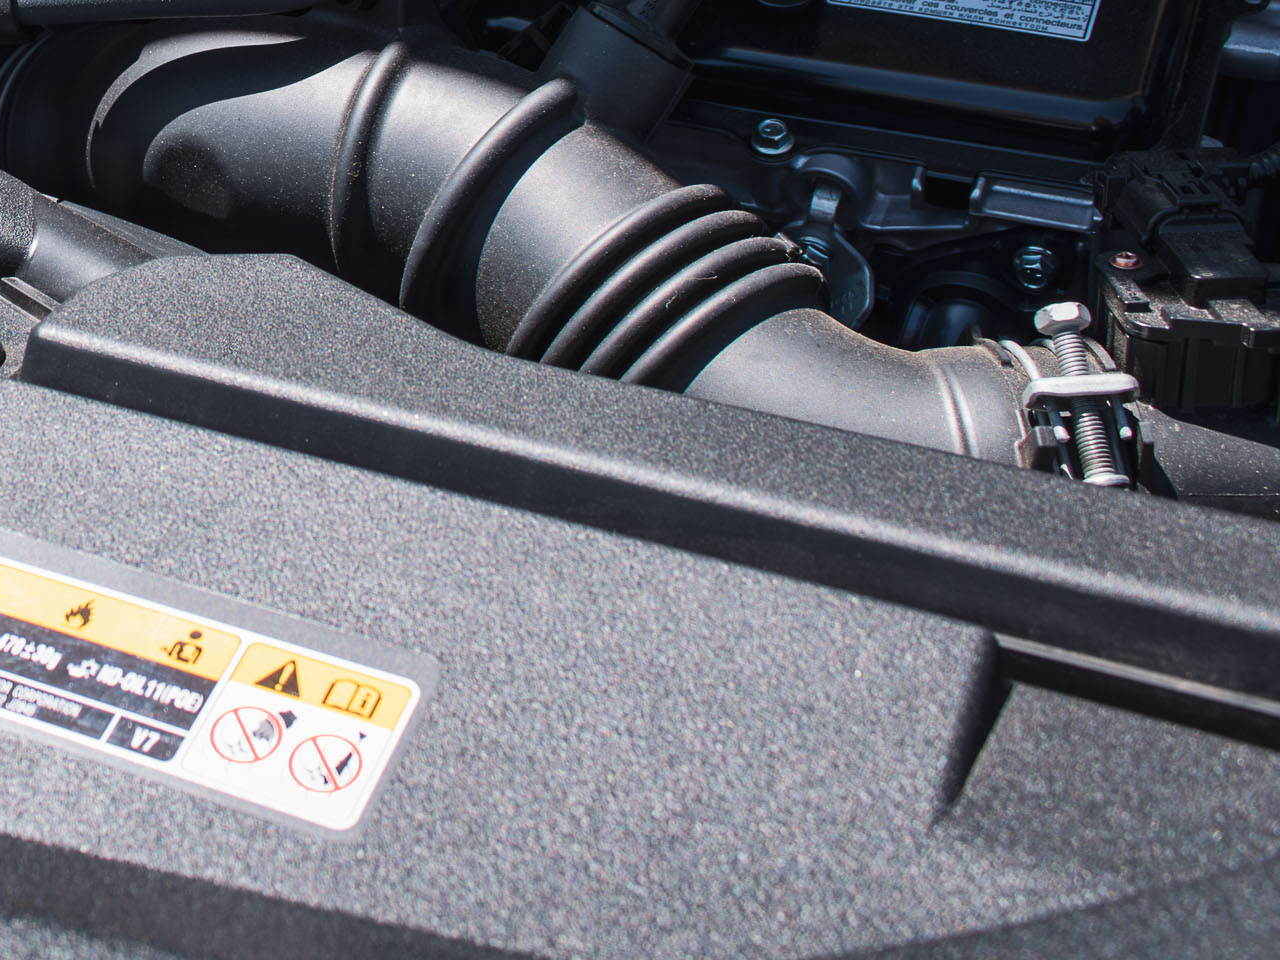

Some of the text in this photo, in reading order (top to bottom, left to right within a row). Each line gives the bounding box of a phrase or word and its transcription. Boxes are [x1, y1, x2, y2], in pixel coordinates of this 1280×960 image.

[944, 4, 999, 17] couvercles
[1018, 15, 1086, 31] connecteurs.
[129, 727, 161, 752] V7
